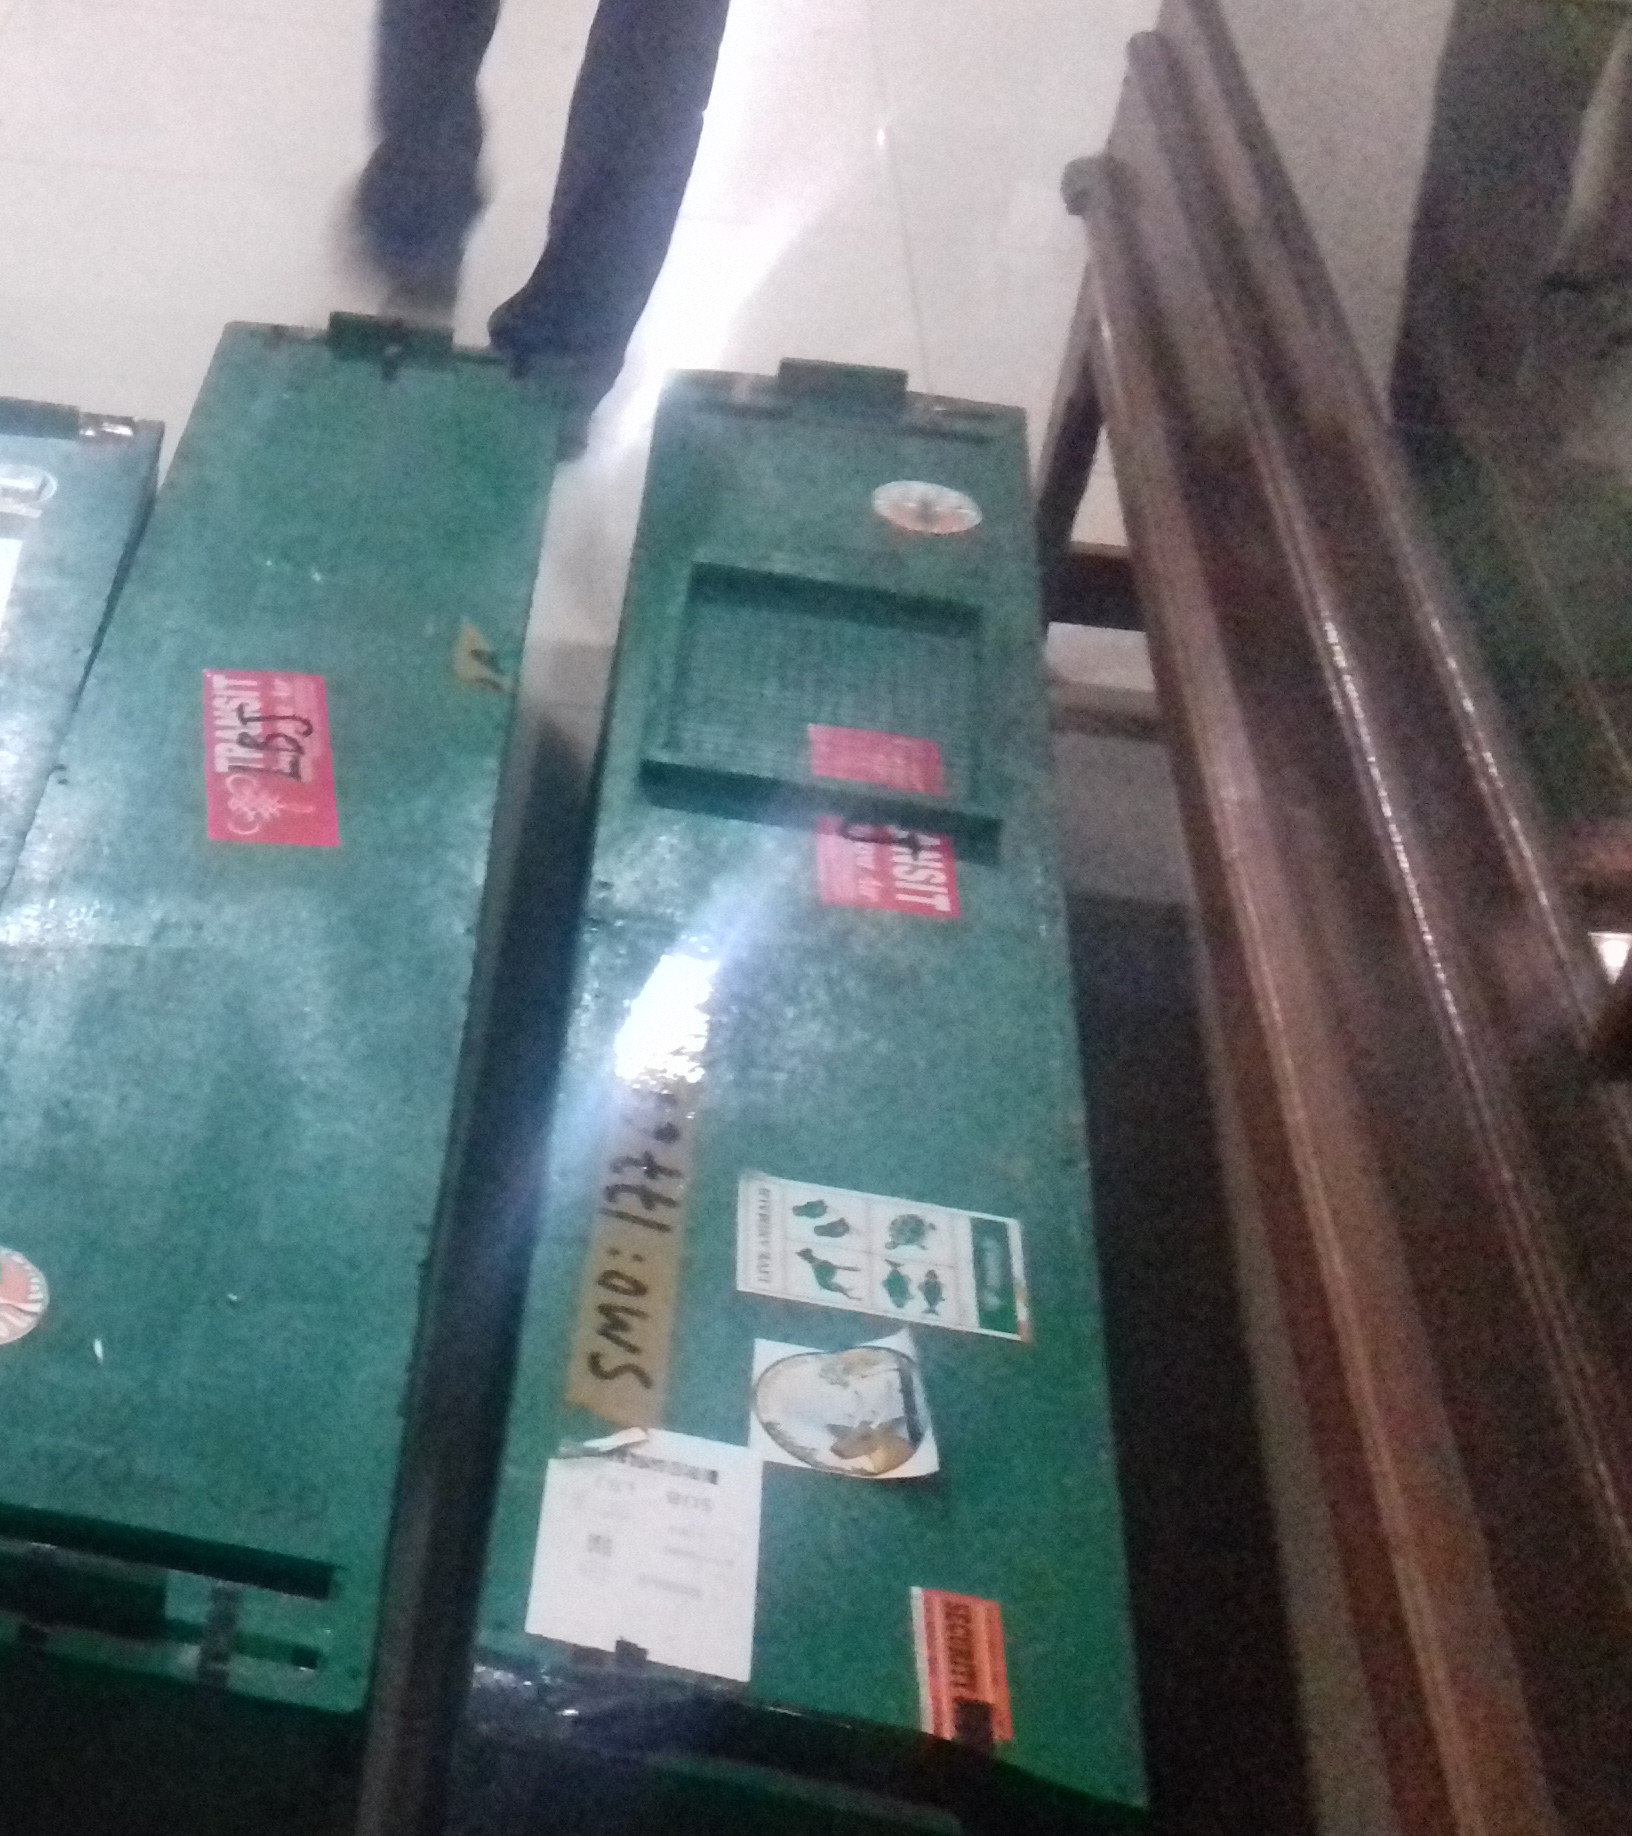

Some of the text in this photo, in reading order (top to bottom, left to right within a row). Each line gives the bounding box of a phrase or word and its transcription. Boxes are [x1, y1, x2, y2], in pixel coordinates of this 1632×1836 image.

[213, 674, 264, 773] TRANSIT
[236, 702, 314, 782] LBJ
[886, 824, 952, 912] ANSIT
[944, 1602, 979, 1694] SECURITY
